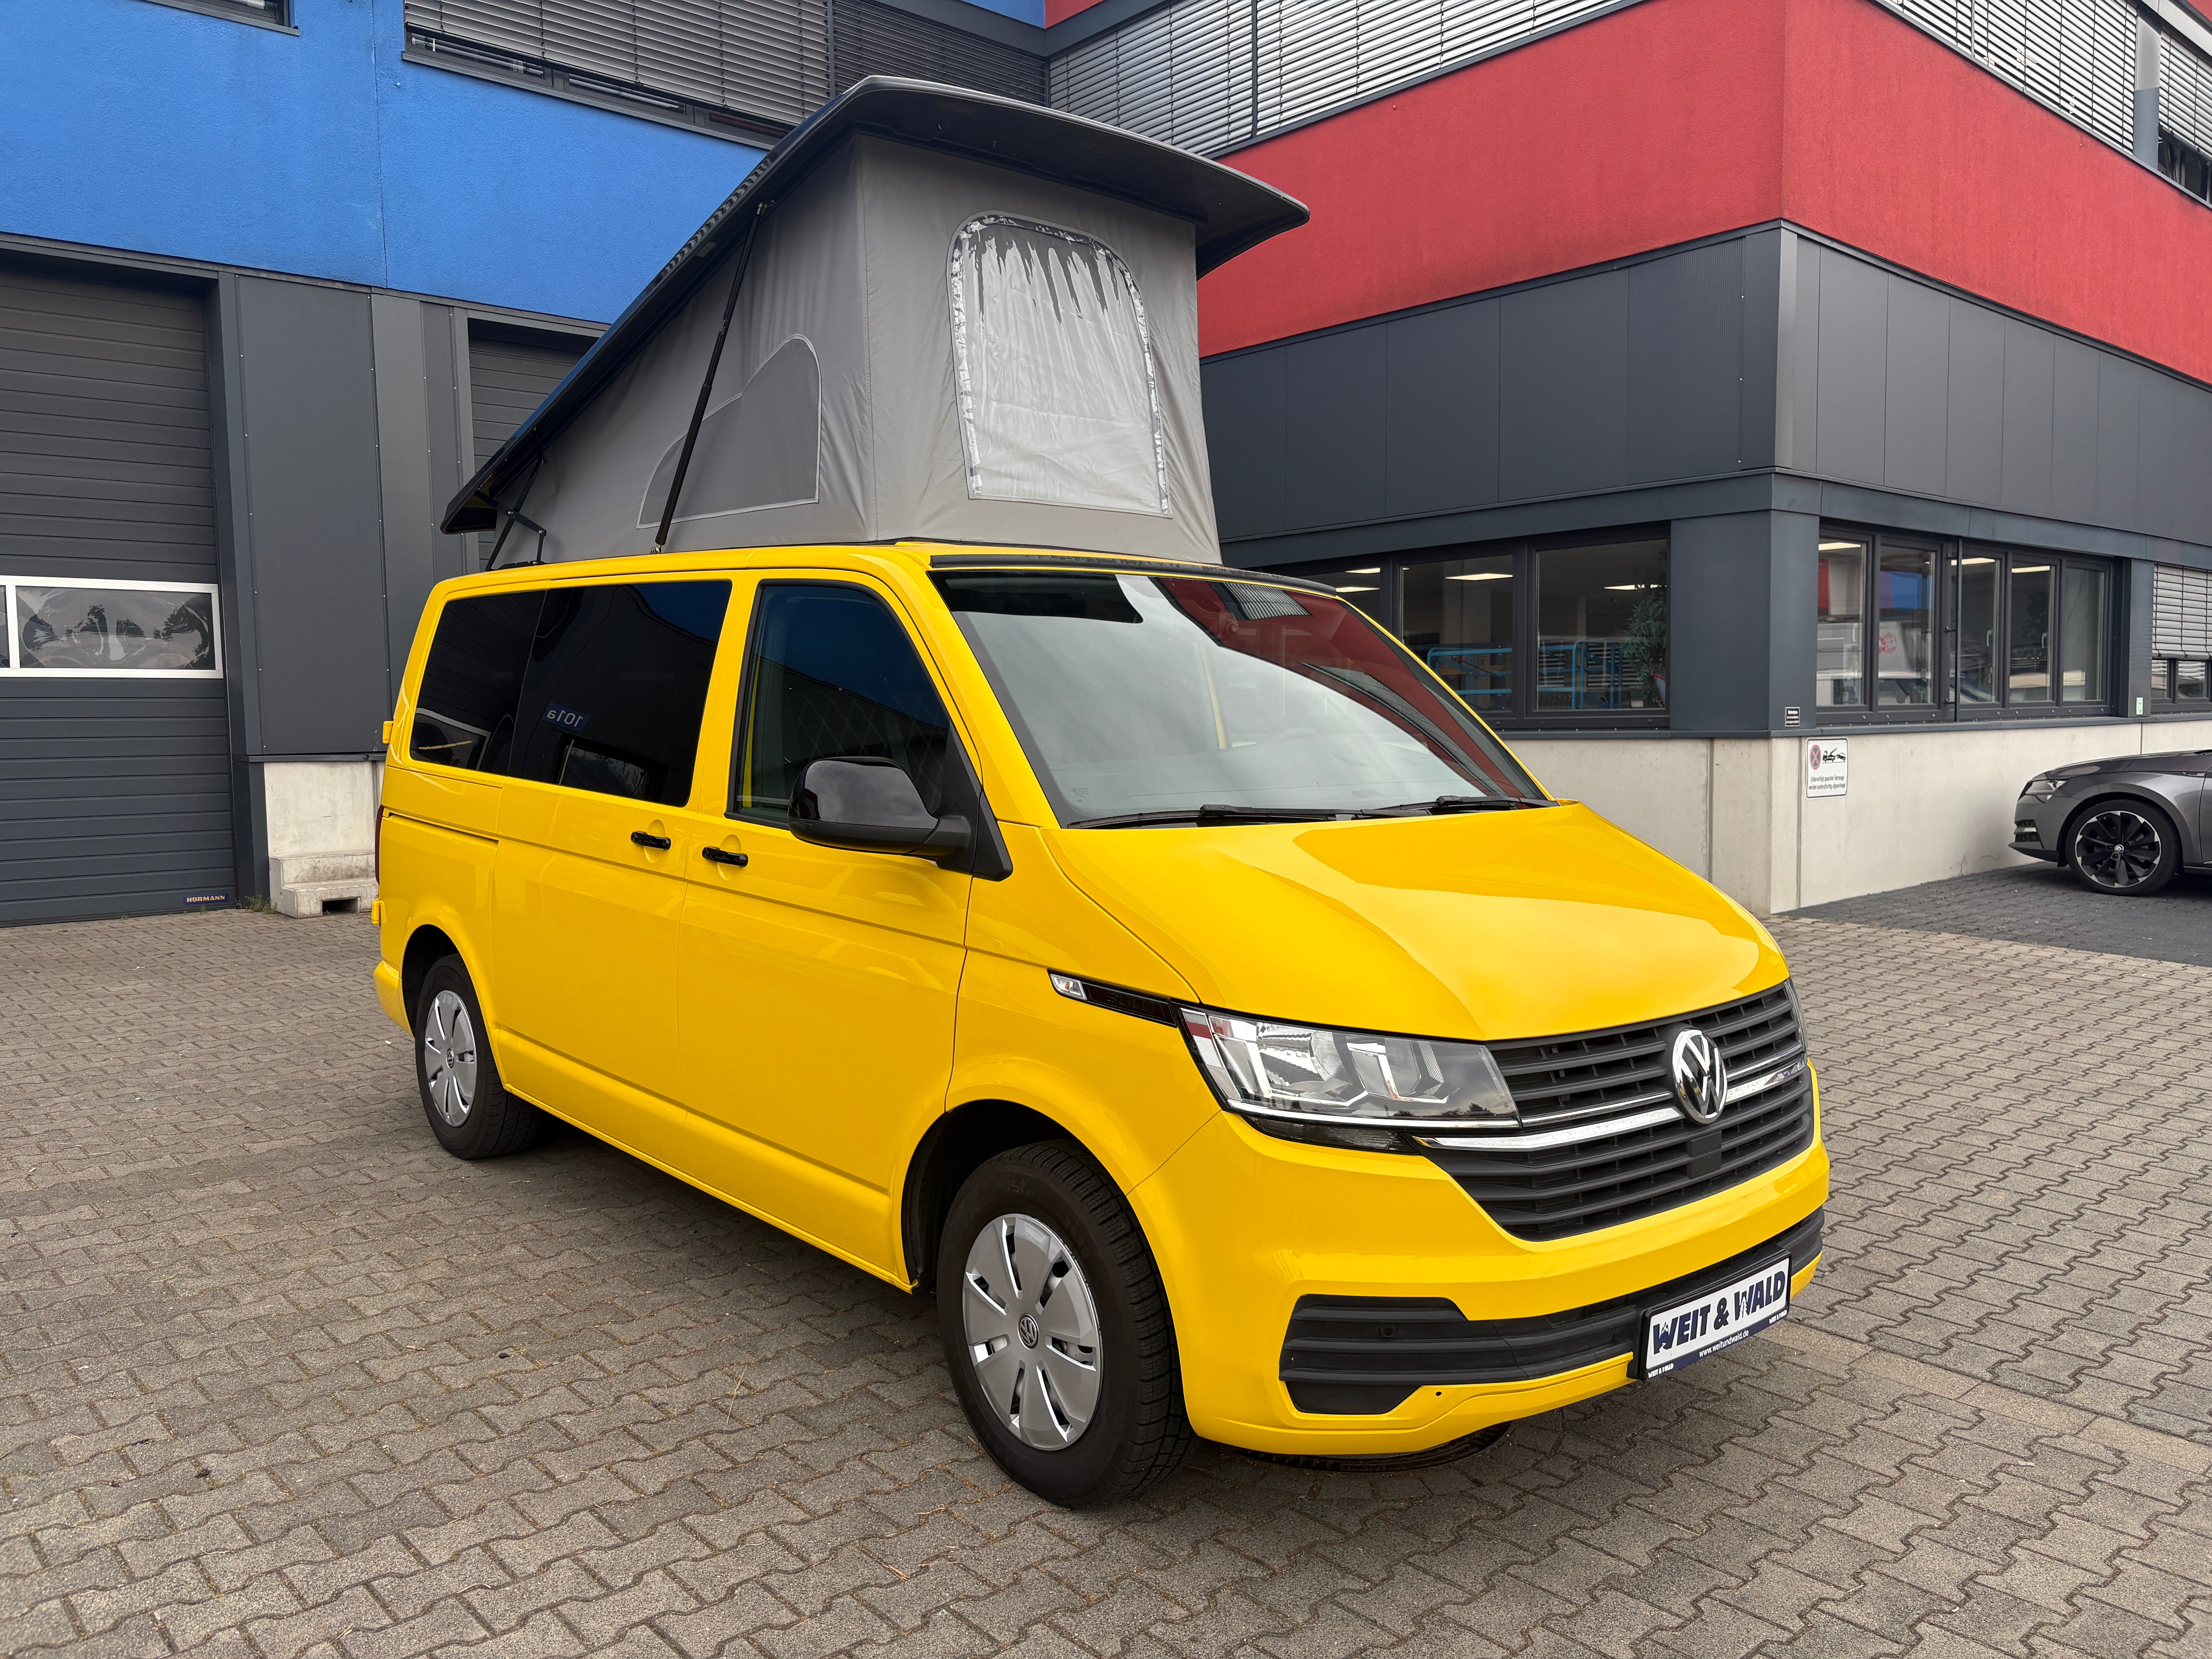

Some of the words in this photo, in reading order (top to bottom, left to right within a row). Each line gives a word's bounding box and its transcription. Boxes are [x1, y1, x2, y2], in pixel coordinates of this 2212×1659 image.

[1653, 1304, 1711, 1355] WEIT
[1714, 1297, 1729, 1330] &
[1734, 1271, 1785, 1321] WALD
[1699, 1329, 1749, 1358] www.weitundwald.de
